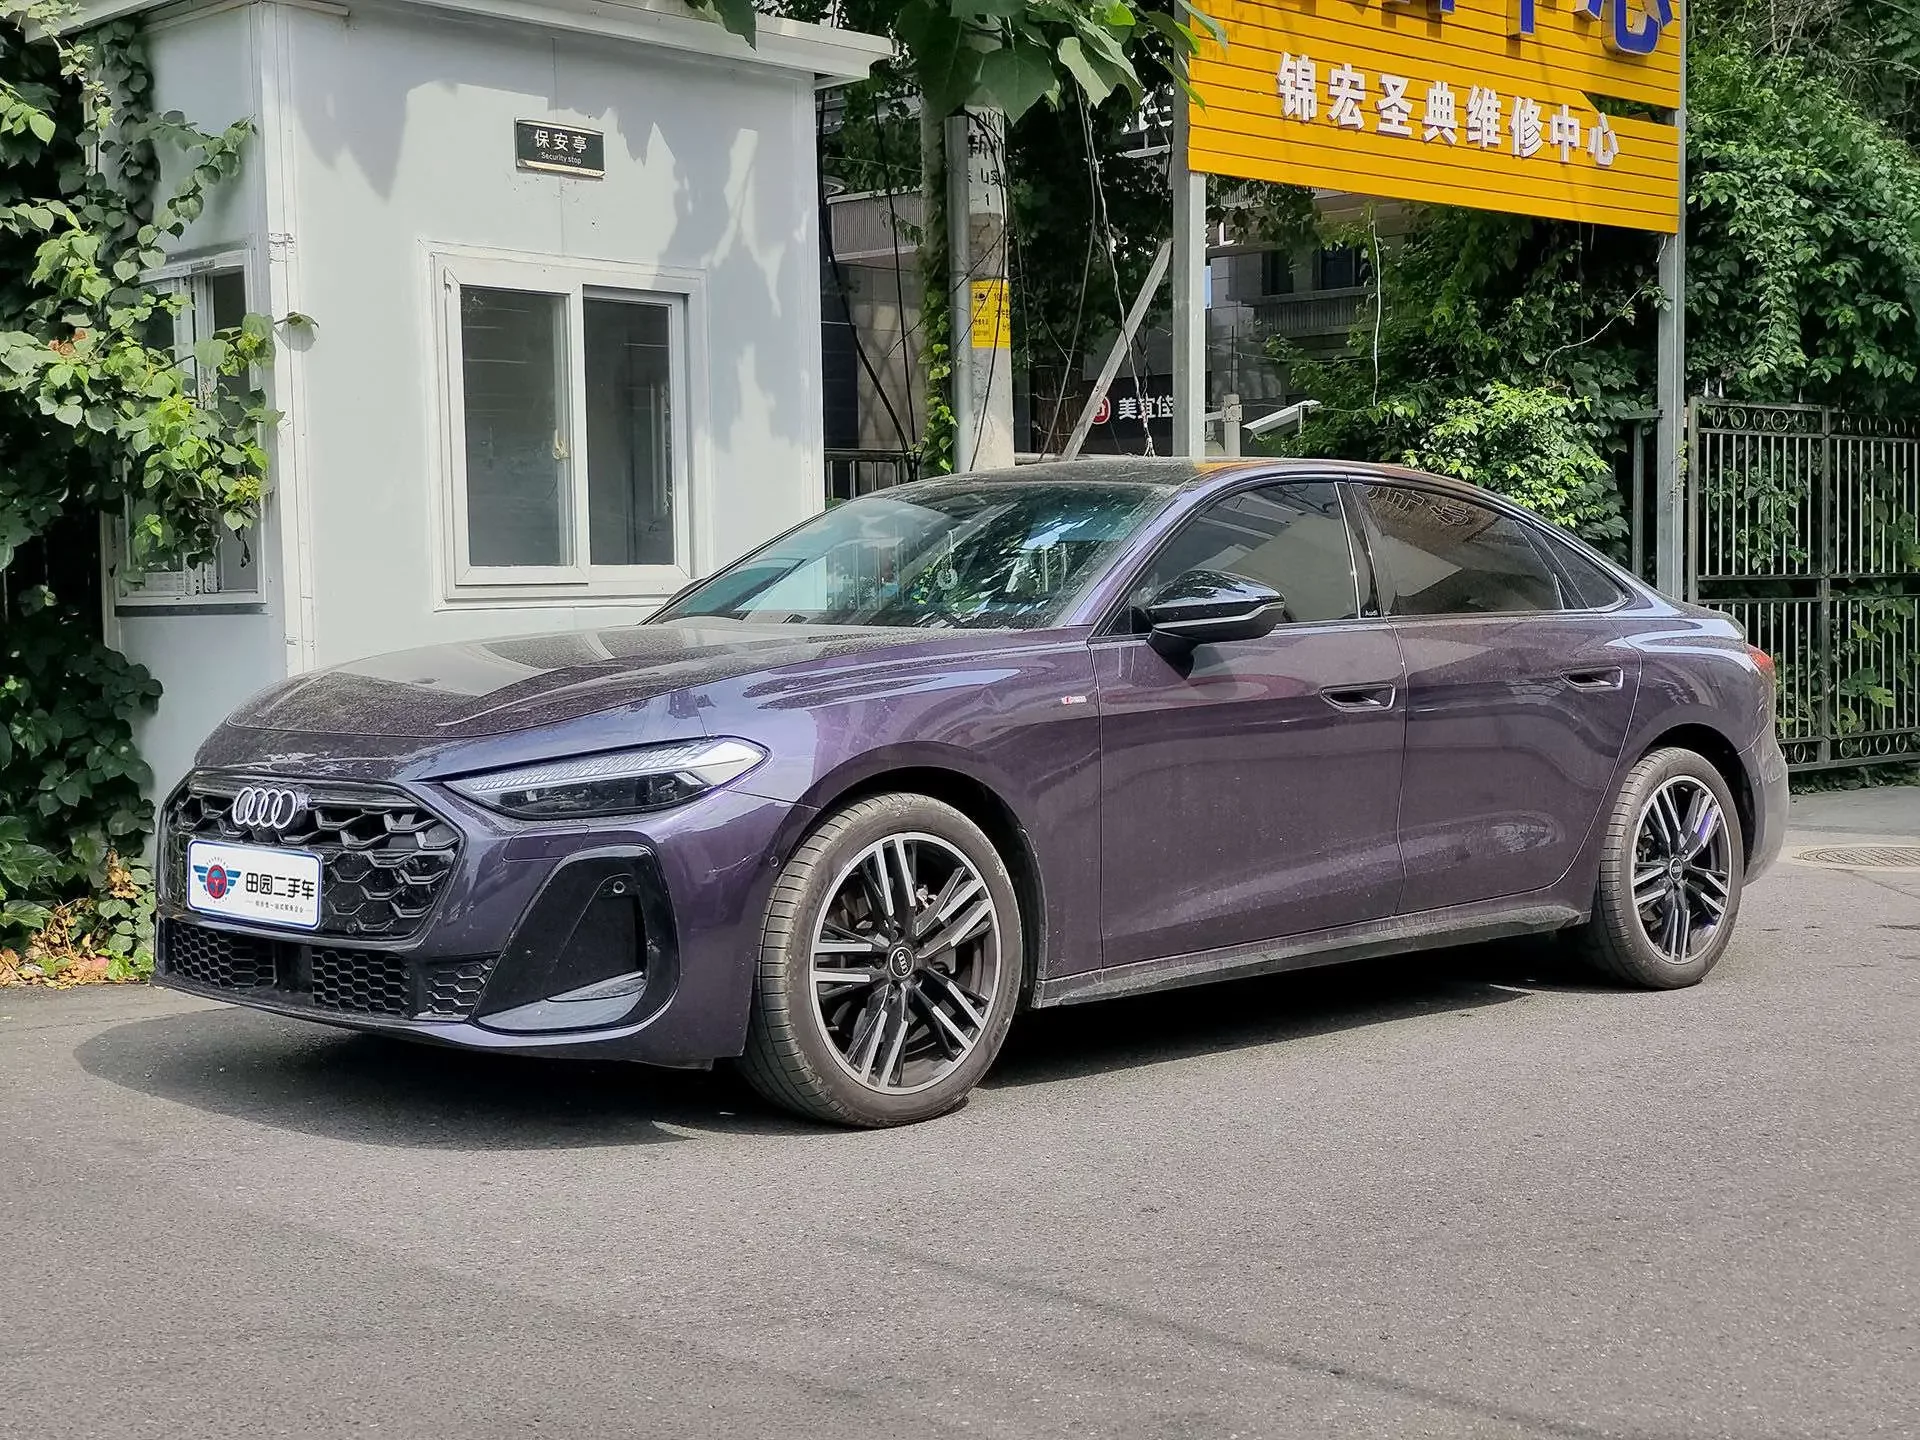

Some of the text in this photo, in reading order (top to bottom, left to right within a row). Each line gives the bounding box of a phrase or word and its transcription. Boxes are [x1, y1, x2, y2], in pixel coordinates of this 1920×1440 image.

[1276, 51, 1620, 166] 锦宏圣典维修中心
[534, 129, 587, 154] 保安亭
[541, 152, 582, 165] Security stop
[246, 872, 314, 900] 田园二手车
